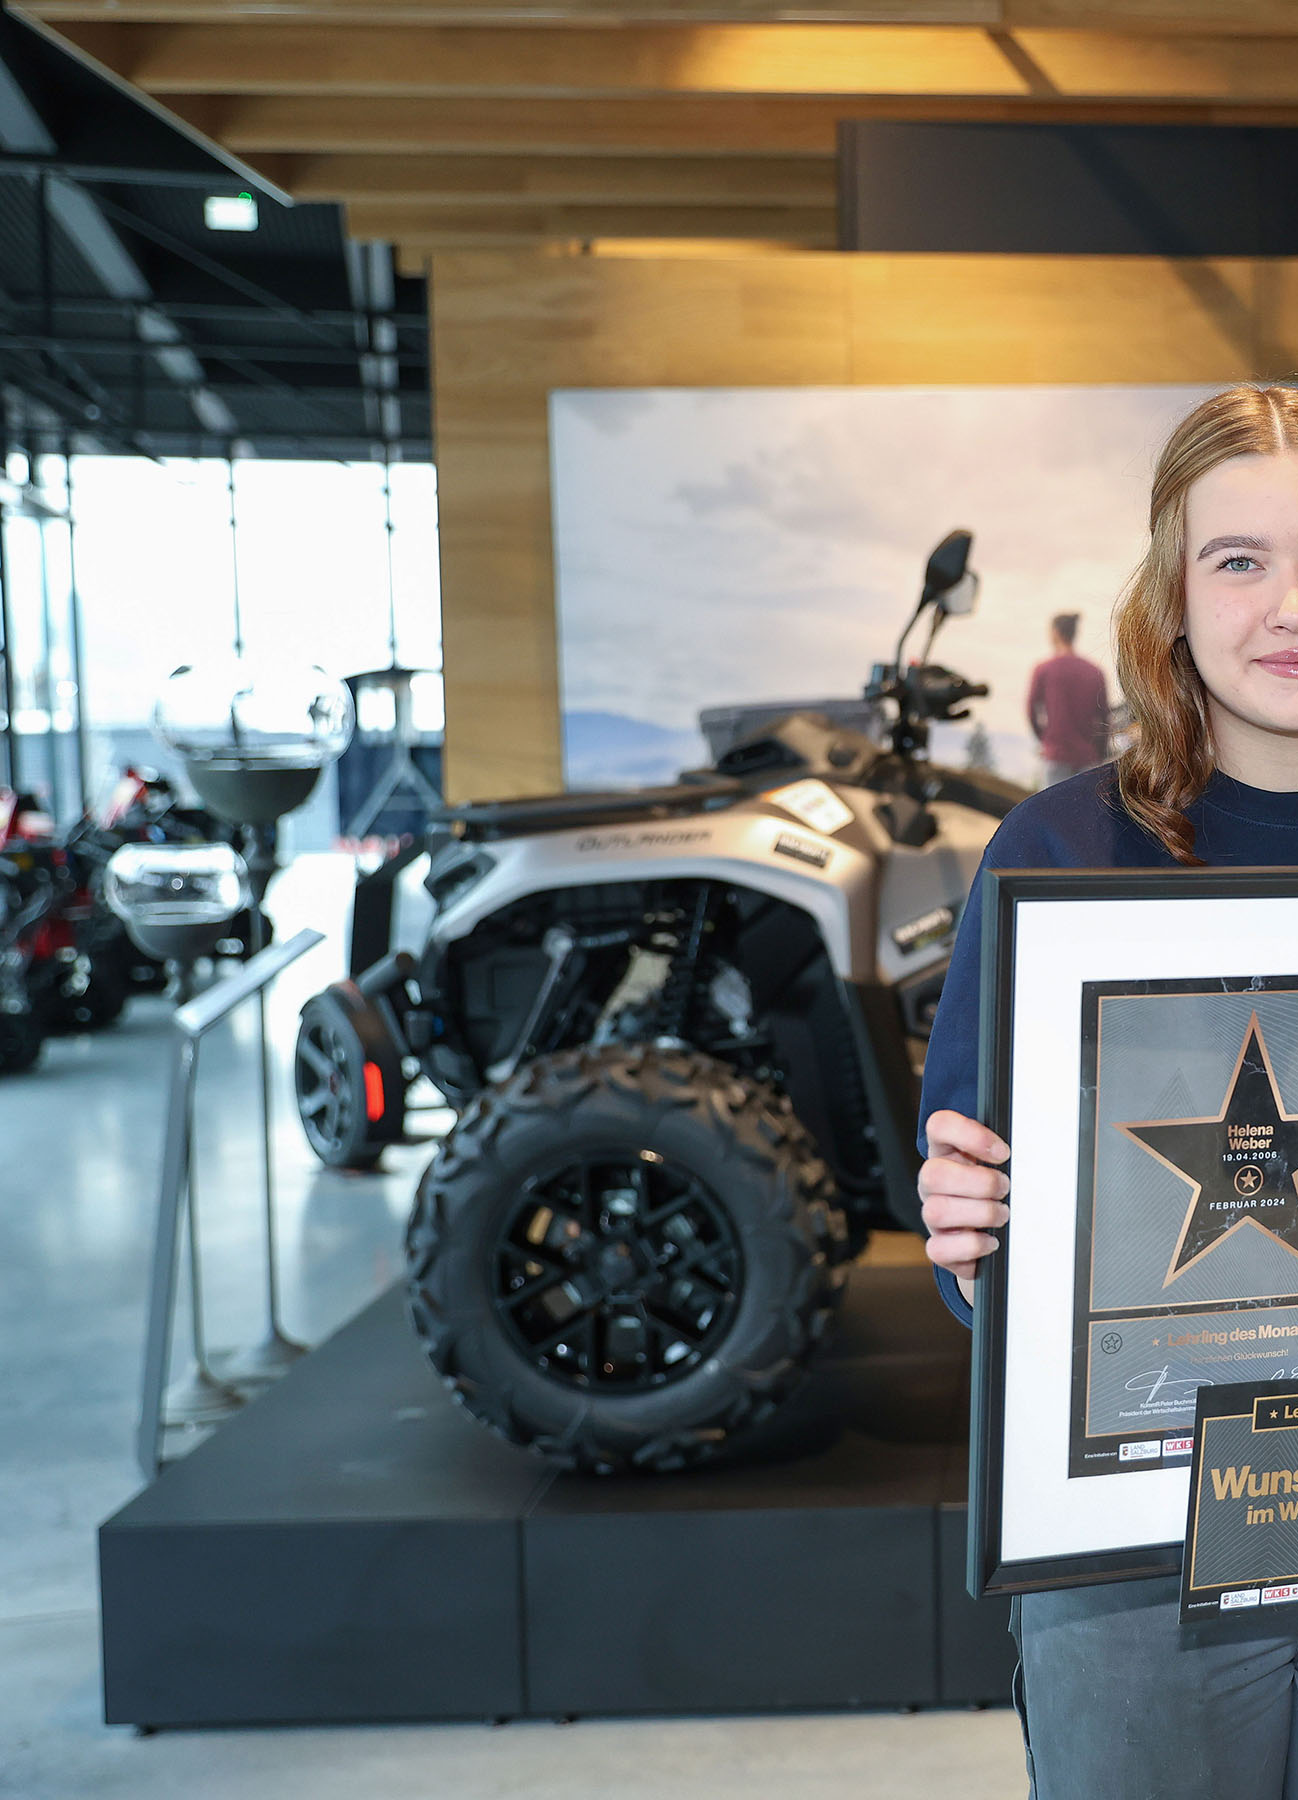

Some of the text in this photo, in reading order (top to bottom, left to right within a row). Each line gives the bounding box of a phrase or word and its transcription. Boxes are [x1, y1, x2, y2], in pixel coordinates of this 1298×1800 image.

[1227, 1124, 1274, 1137] Helena
[1229, 1137, 1272, 1150] Weber
[1209, 1198, 1285, 1211] FEBRUAR 2024
[1167, 1330, 1228, 1347] Lehrling
[1229, 1327, 1257, 1341] des
[1234, 1348, 1289, 1361] Glückwunsch!
[1246, 1505, 1274, 1525] im
[1264, 1588, 1290, 1599] WKS
